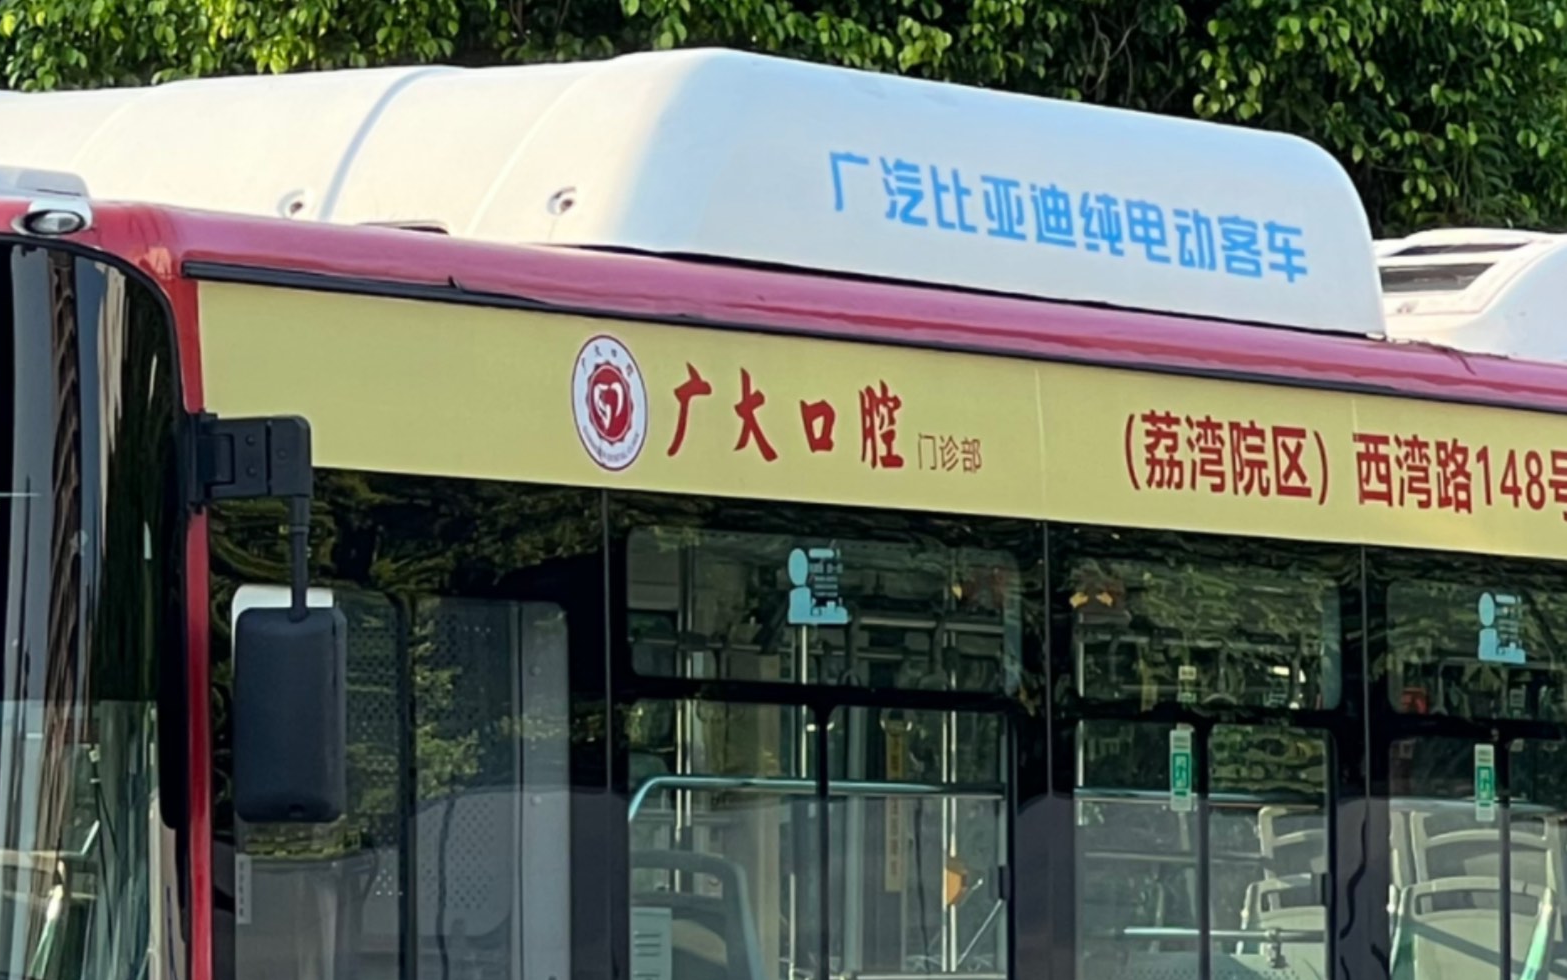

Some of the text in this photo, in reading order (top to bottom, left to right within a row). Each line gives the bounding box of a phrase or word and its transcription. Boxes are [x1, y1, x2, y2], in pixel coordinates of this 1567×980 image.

[828, 150, 1309, 283] 广汽比亚迪纯电动客车
[667, 361, 905, 470] 广大口腔
[917, 433, 982, 474] 门诊部
